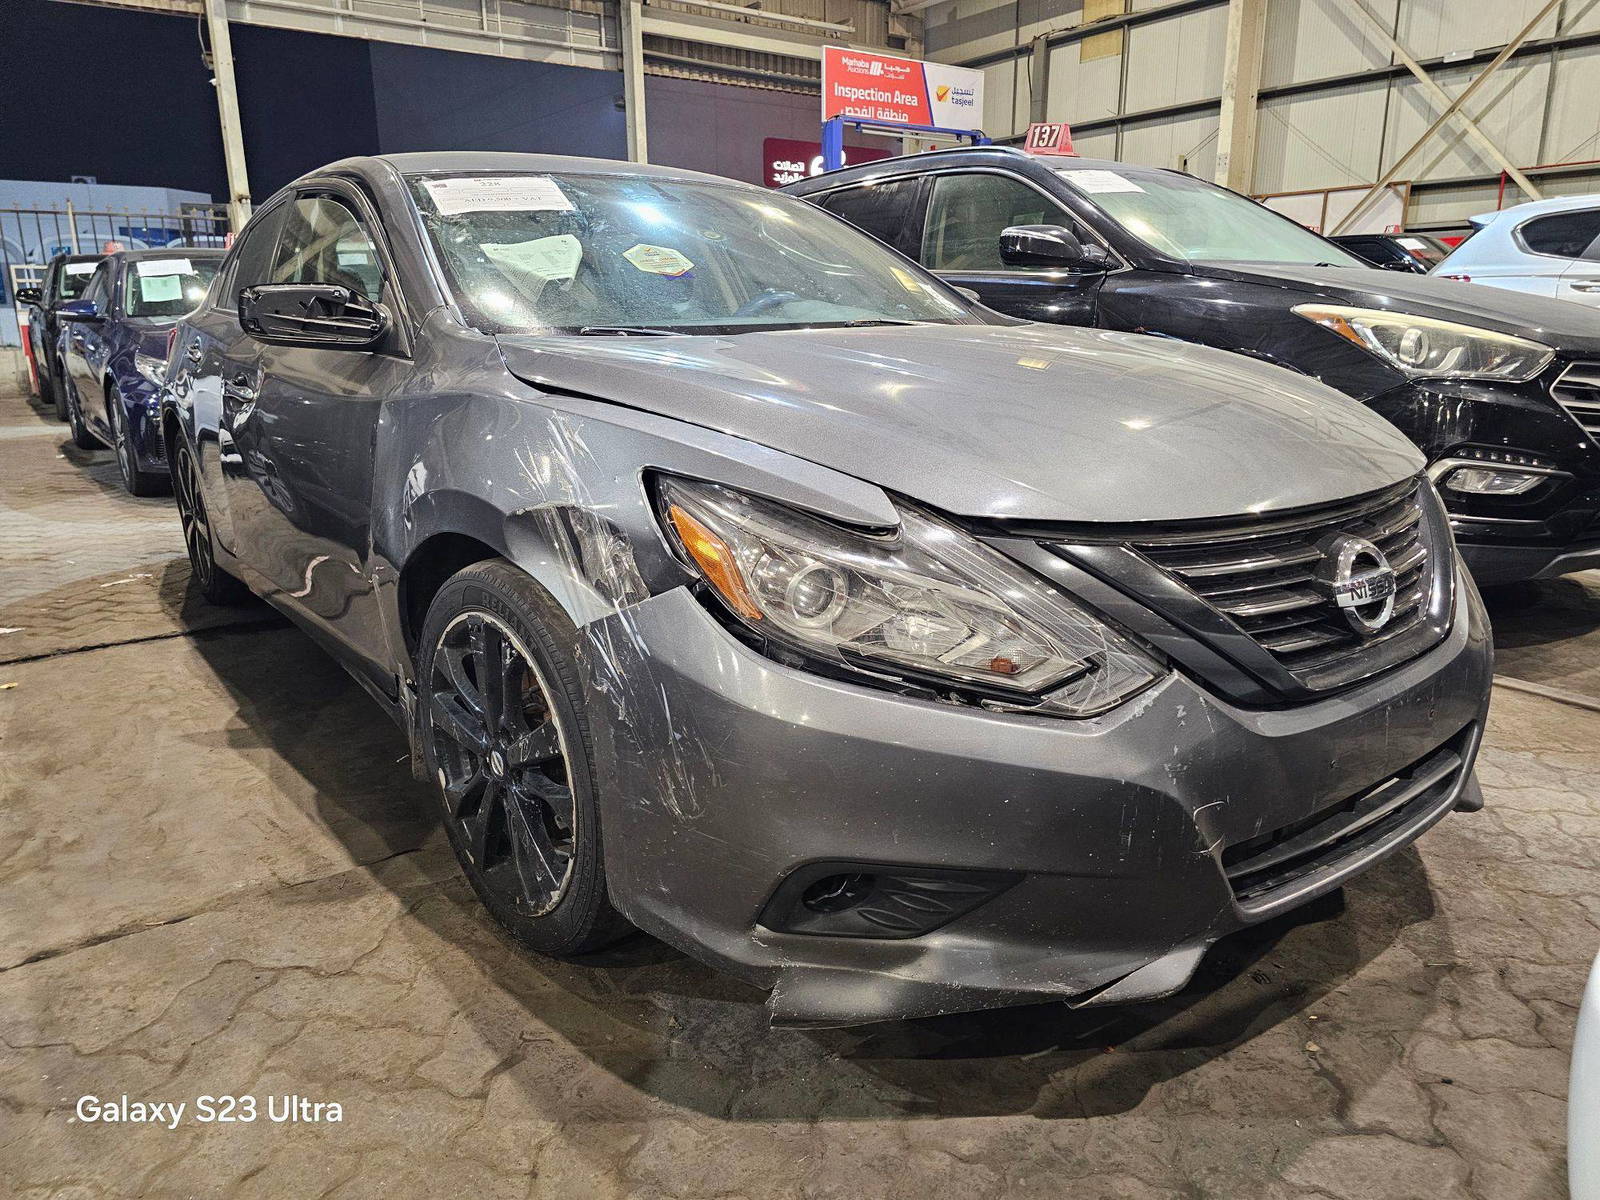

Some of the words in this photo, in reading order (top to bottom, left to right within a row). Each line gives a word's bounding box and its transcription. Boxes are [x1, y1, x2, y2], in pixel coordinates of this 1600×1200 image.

[841, 56, 870, 69] Marhaba
[834, 82, 892, 103] Inspection
[894, 89, 918, 107] Area
[951, 97, 974, 107] tasjeel
[877, 106, 909, 122] منطقة
[1032, 125, 1060, 148] 137
